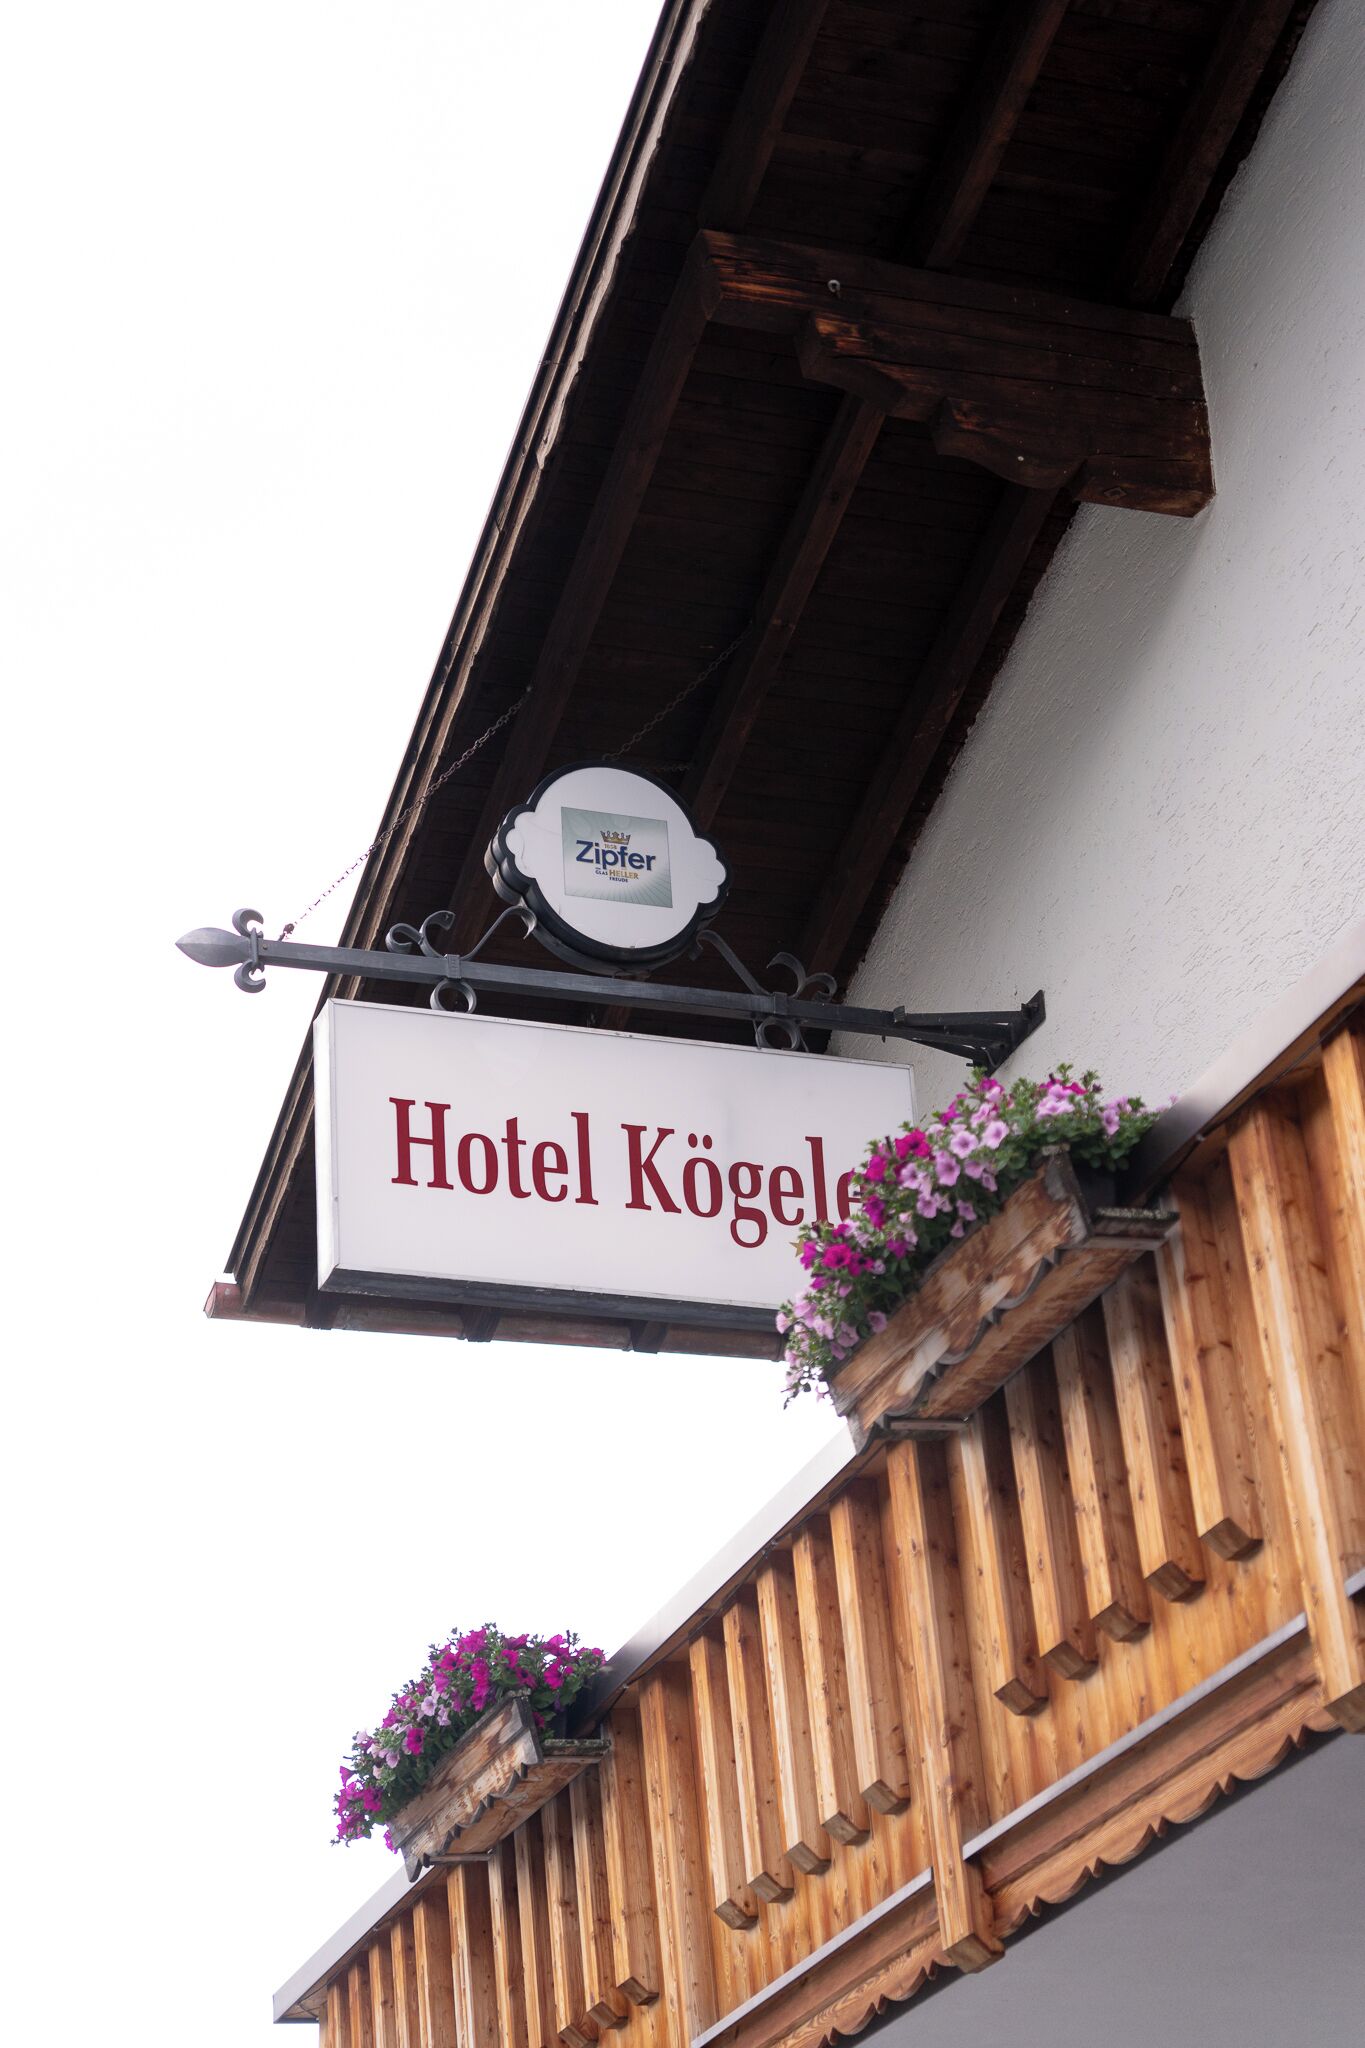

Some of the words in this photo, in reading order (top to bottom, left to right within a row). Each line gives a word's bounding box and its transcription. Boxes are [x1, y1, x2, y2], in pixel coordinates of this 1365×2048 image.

[576, 840, 656, 871] Zipfer
[609, 869, 639, 879] HELLER
[389, 1097, 599, 1206] Hotel
